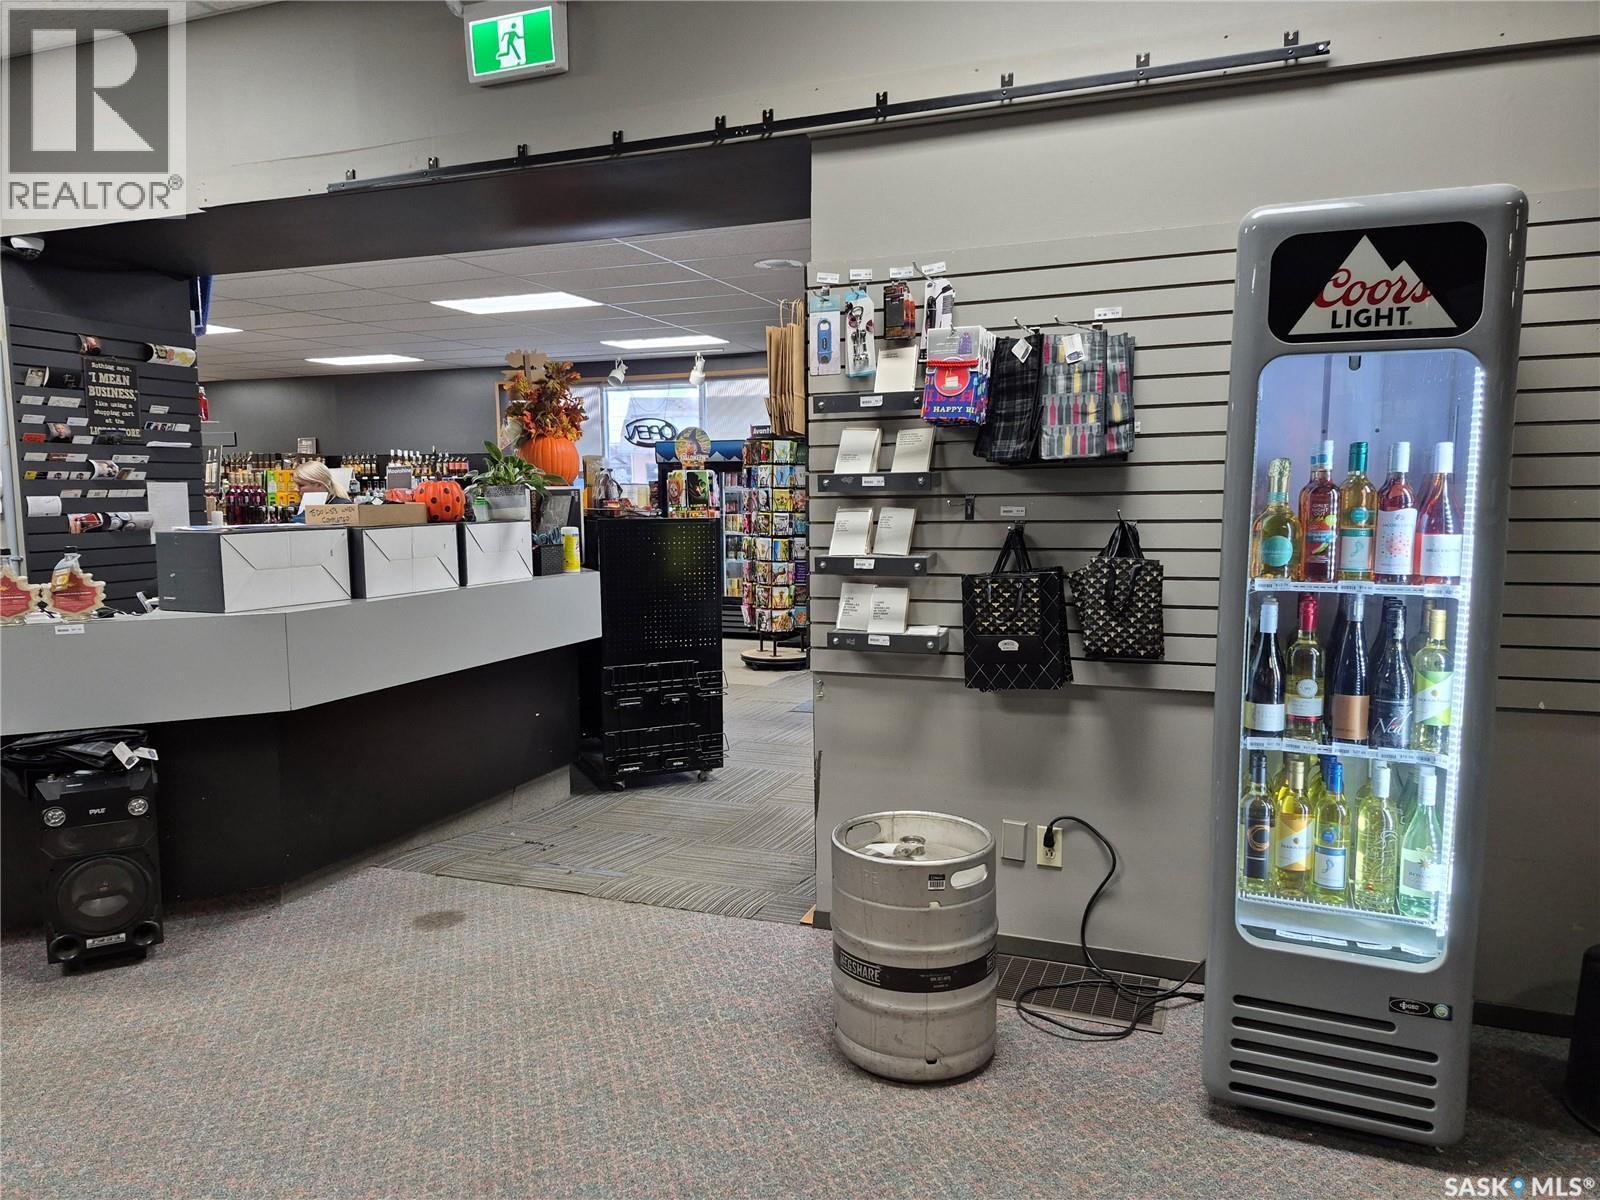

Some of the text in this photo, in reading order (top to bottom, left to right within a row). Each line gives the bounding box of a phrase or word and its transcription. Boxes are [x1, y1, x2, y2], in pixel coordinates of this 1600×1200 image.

[1314, 268, 1432, 308] Coors
[91, 362, 115, 370] Nothing
[98, 373, 130, 386] MEAN
[93, 409, 121, 417] shopping
[1372, 710, 1413, 736] Ned
[88, 807, 107, 816] PYLE
[840, 953, 881, 983] KEGSHARE
